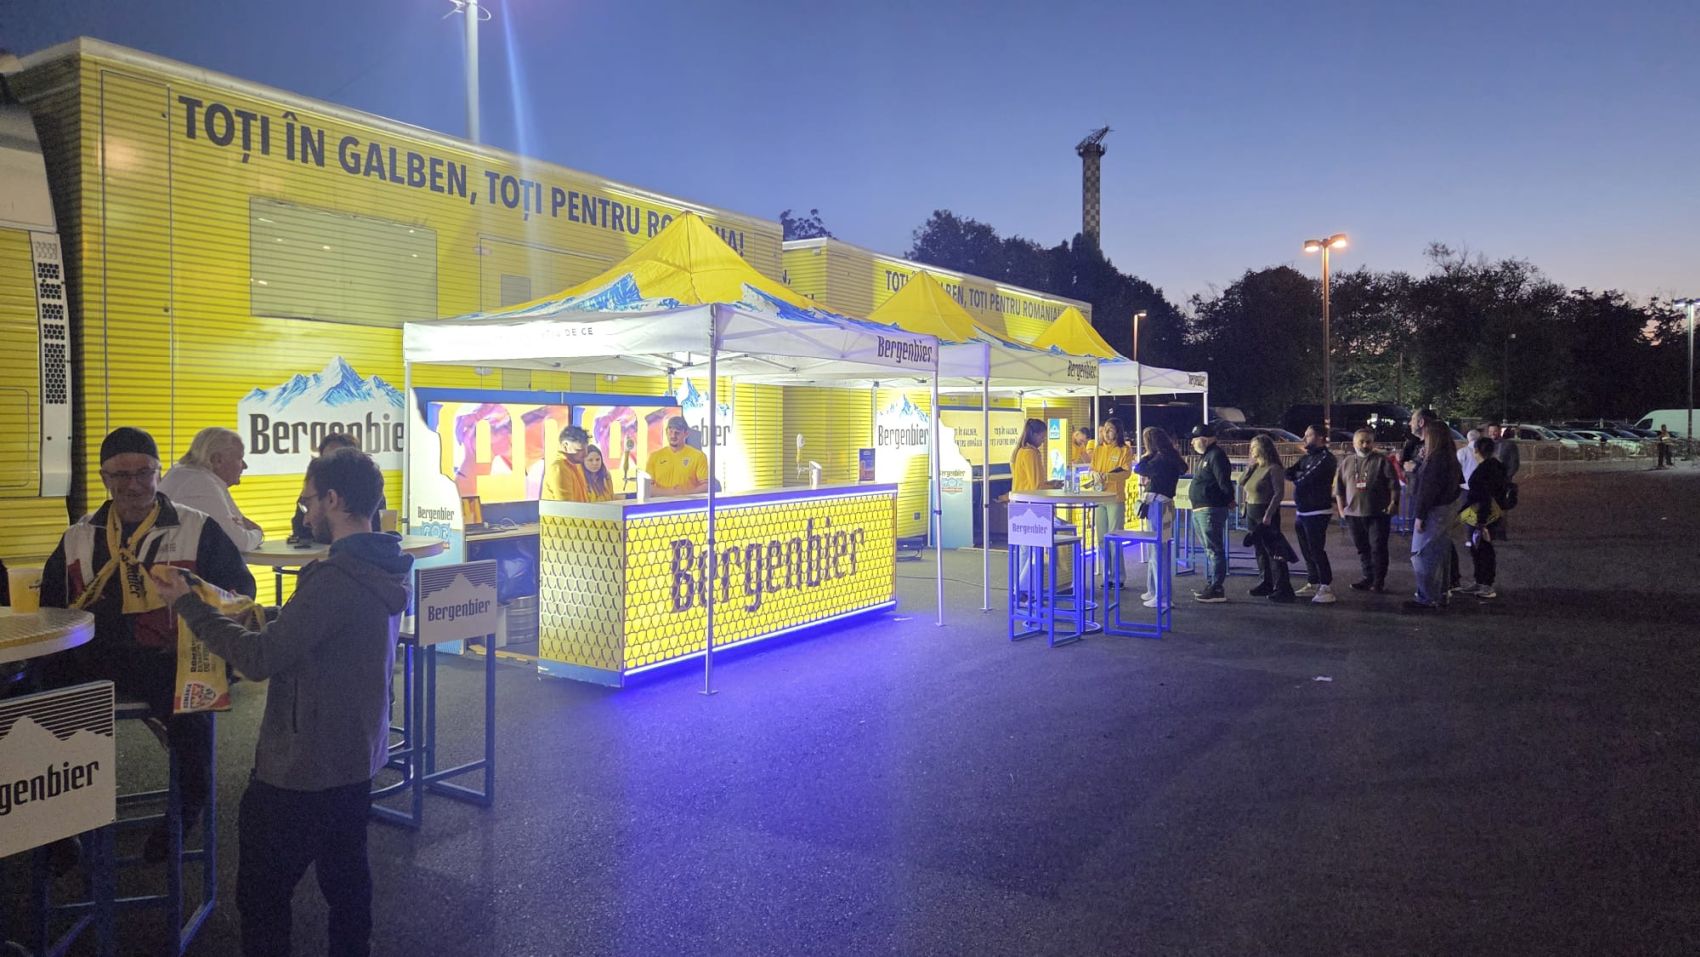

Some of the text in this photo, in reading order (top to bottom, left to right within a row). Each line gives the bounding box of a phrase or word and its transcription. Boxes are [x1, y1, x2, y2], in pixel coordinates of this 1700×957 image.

[178, 96, 270, 163] TOȚI
[283, 111, 325, 167] ÎN
[338, 135, 477, 205] GALBEN,
[485, 170, 542, 221] TOȚI
[551, 187, 640, 235] PENTRU
[990, 293, 1021, 316] PENTRU
[581, 327, 594, 336] CE
[878, 423, 929, 450] Bergenbier
[417, 505, 455, 521] Bergenbier
[428, 598, 491, 621] Bergenbier
